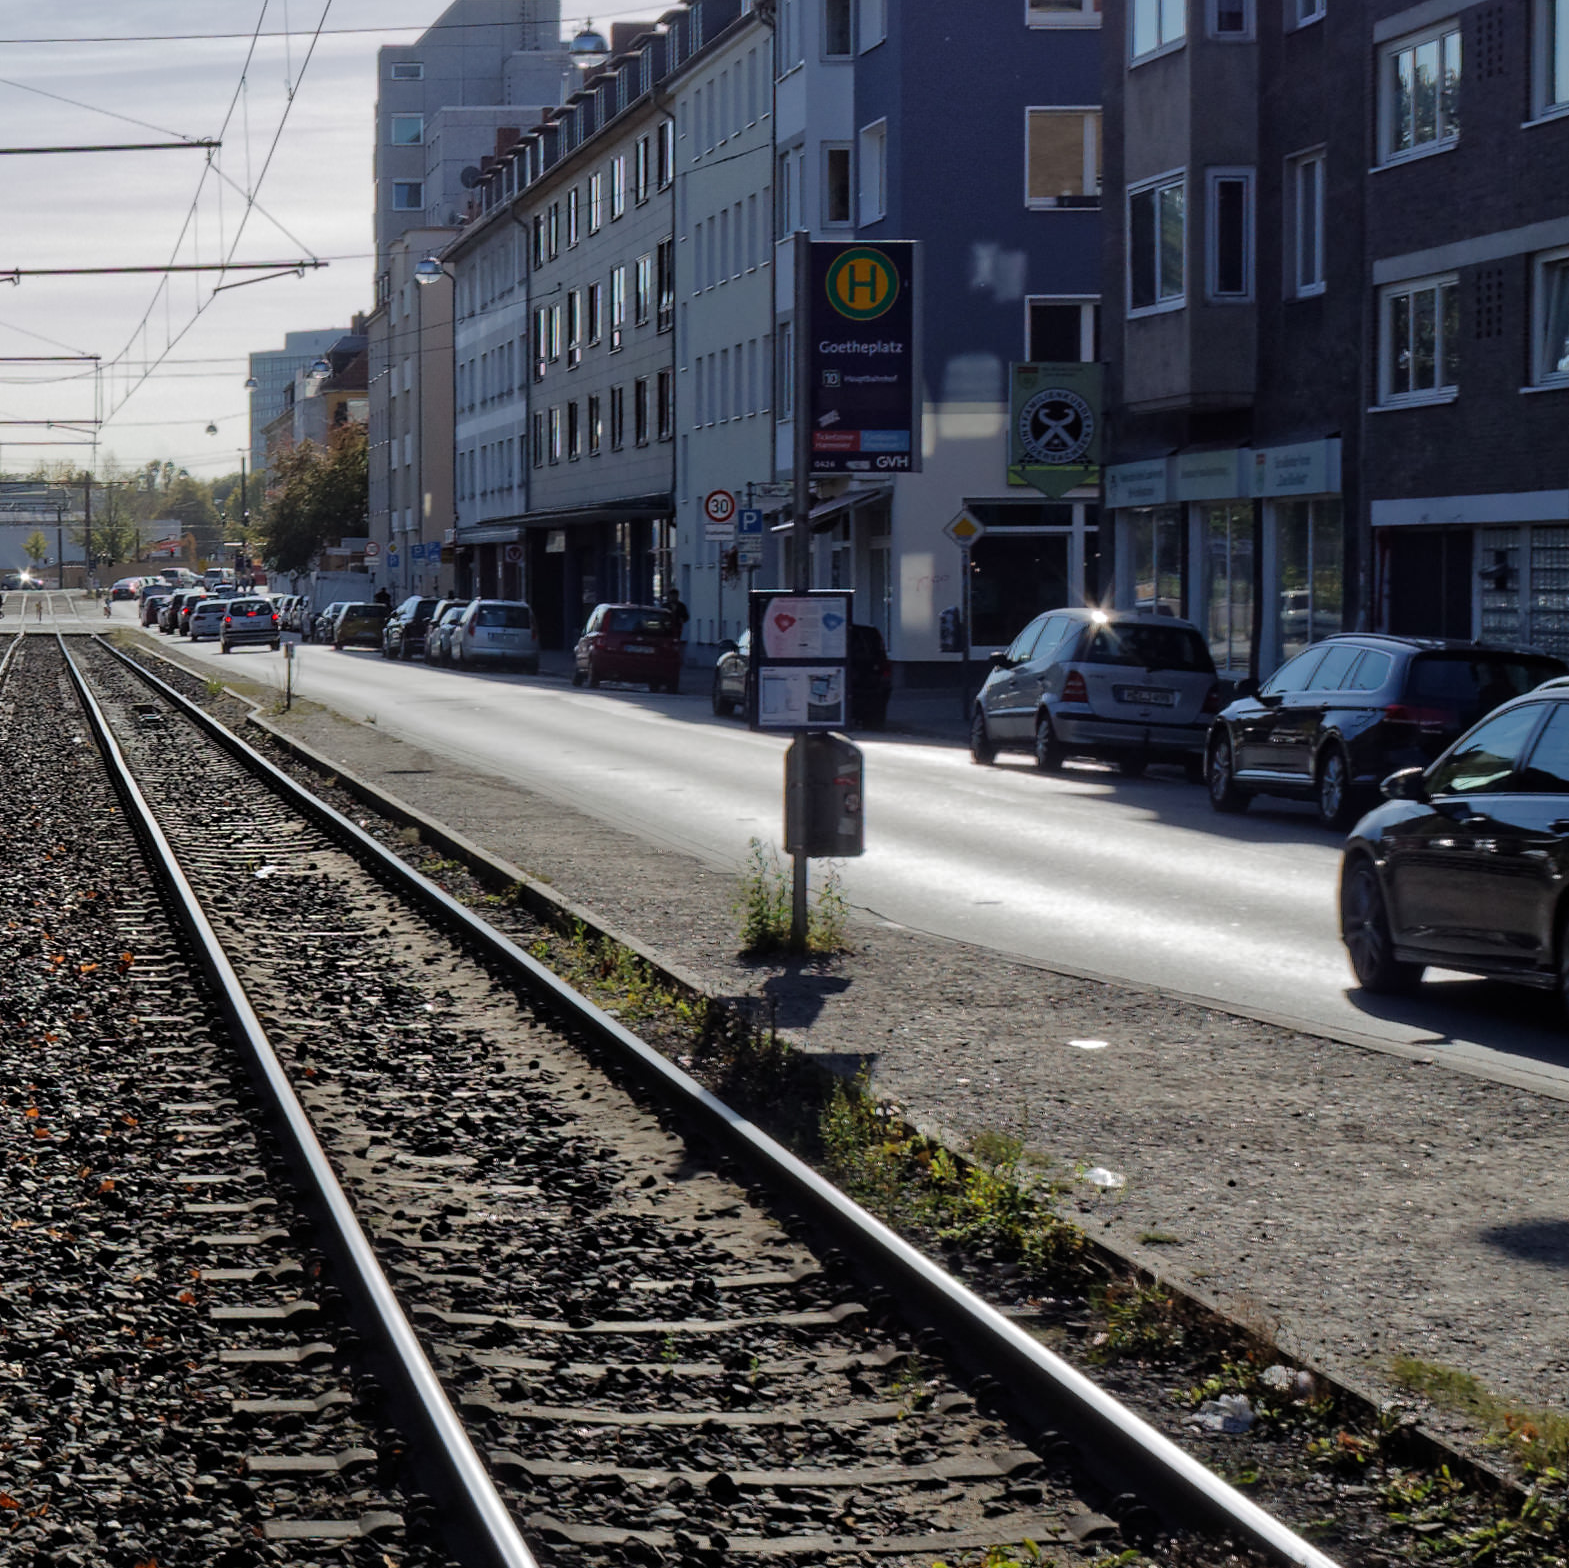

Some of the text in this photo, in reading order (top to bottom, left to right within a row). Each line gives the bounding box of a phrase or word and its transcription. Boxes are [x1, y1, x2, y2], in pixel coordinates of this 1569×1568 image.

[847, 264, 877, 303] H
[819, 339, 903, 357] Goetheplatz
[824, 372, 838, 385] 10
[876, 455, 909, 469] GVH
[711, 498, 729, 514] 30
[743, 511, 757, 531] P
